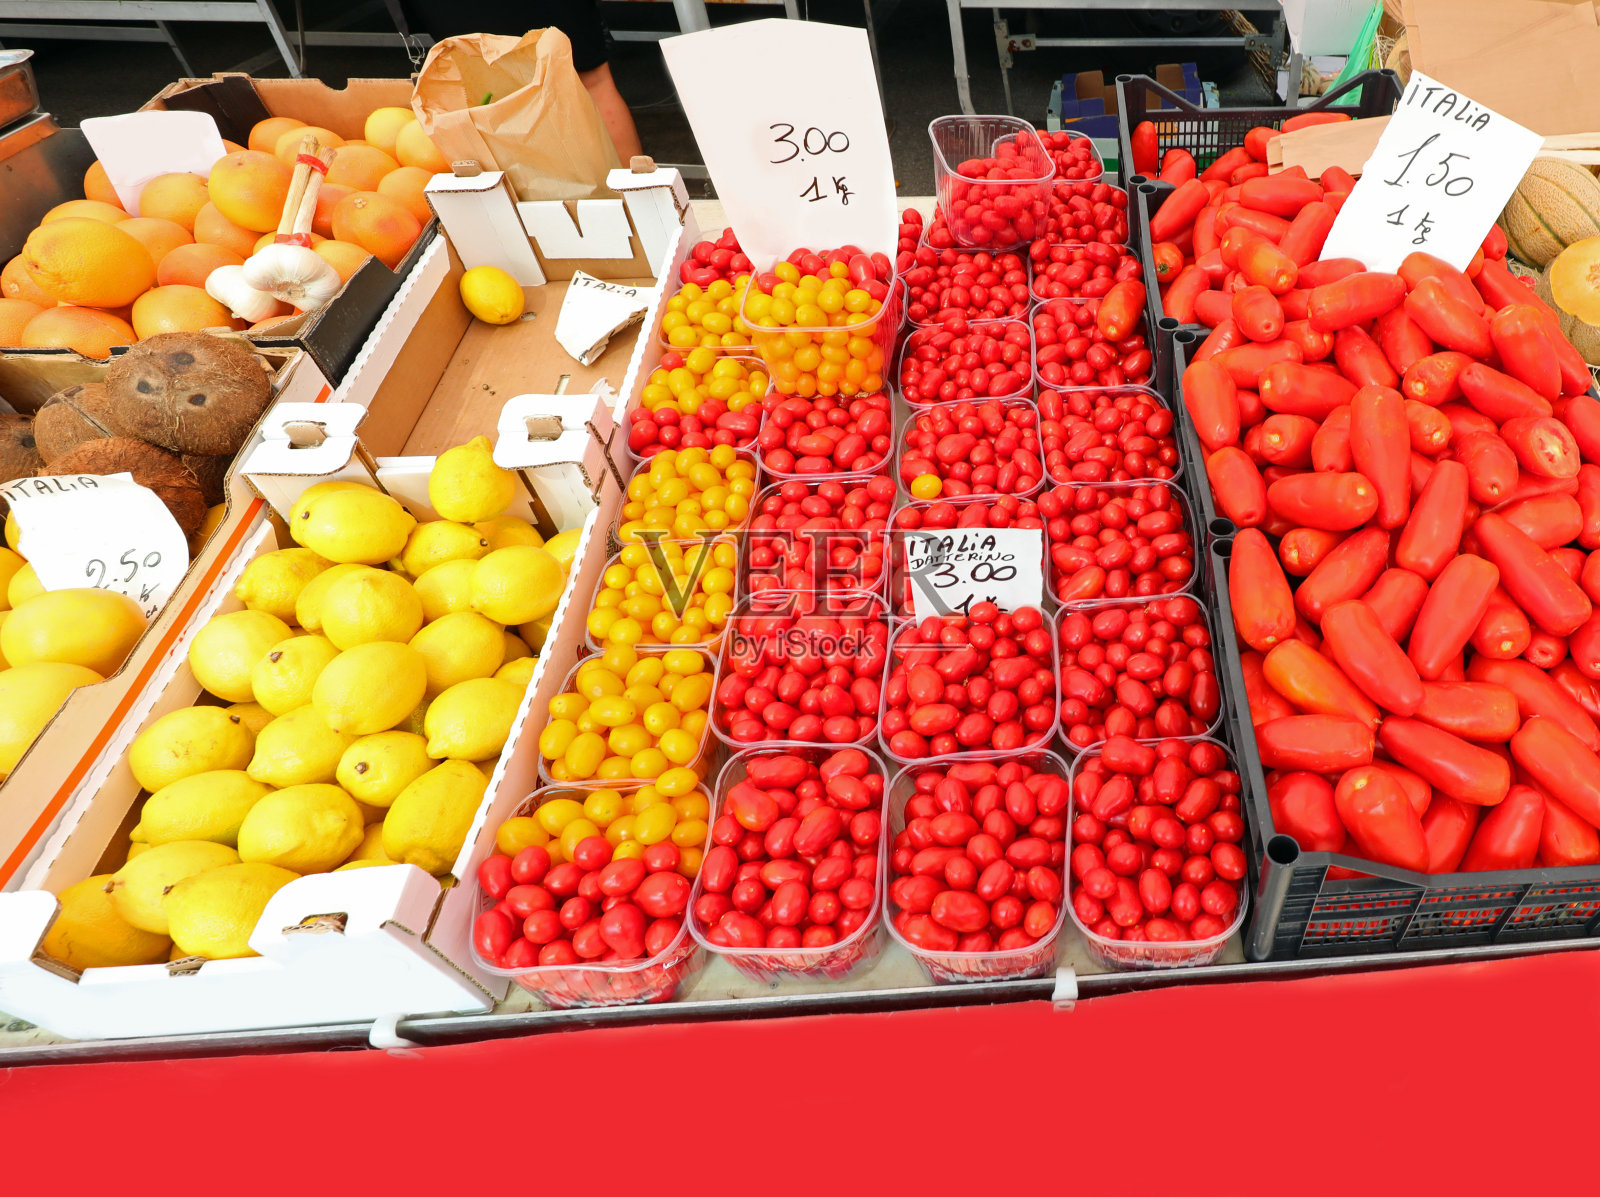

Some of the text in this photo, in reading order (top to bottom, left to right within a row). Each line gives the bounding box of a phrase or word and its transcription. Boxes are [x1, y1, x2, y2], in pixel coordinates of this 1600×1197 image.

[769, 122, 850, 164] 3.00
[1383, 132, 1474, 197] 1.50
[799, 176, 828, 203] 1
[1386, 204, 1410, 226] 1
[86, 548, 162, 590] 2.50
[931, 562, 1018, 589] 3.00
